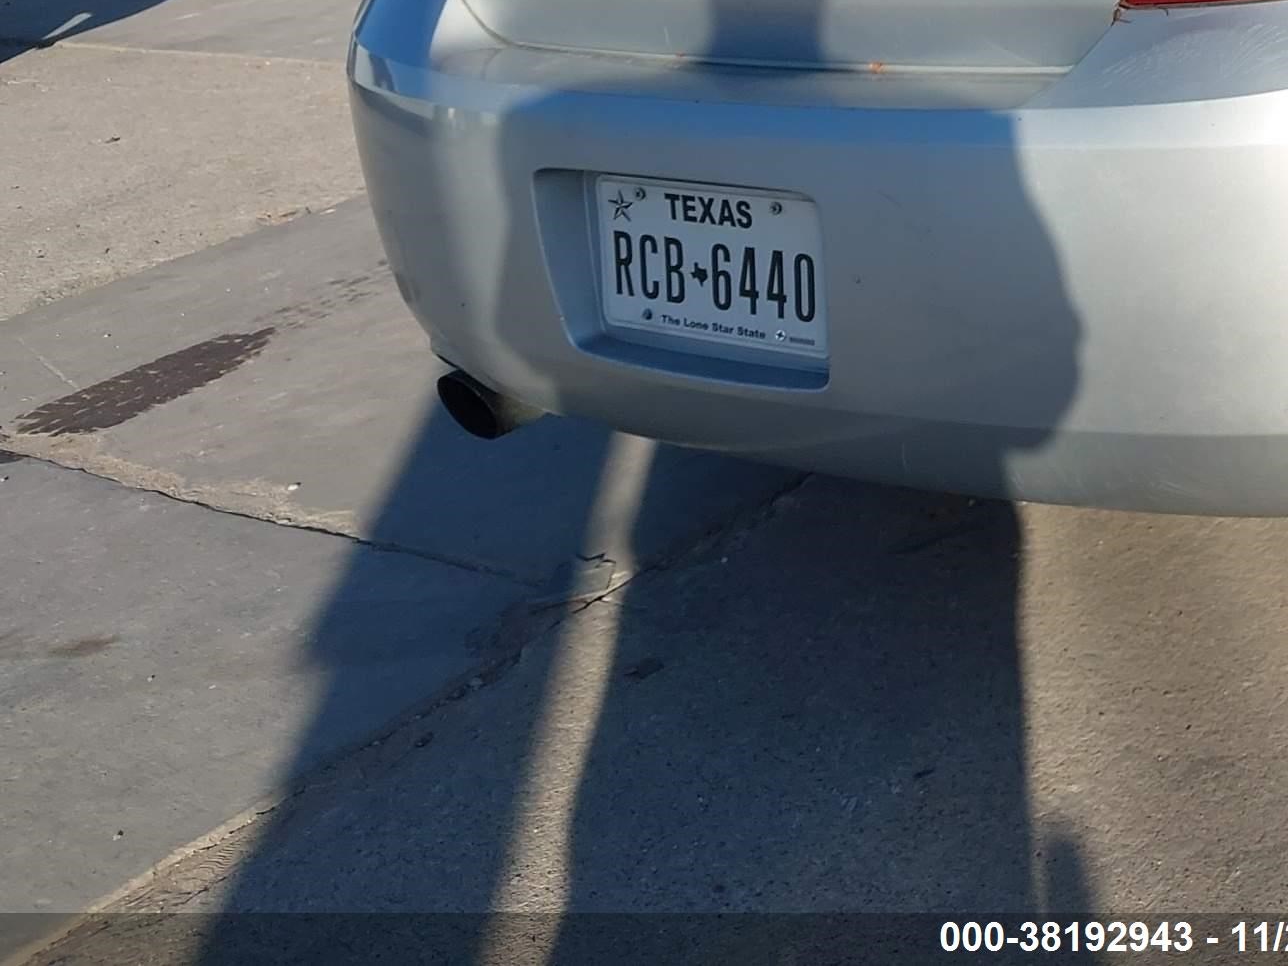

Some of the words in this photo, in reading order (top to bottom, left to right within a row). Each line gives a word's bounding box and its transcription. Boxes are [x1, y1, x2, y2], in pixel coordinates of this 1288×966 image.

[664, 193, 753, 229] TEXAS
[661, 314, 681, 326] The
[684, 318, 709, 331] Lone
[712, 322, 735, 335] Star
[737, 326, 767, 340] State
